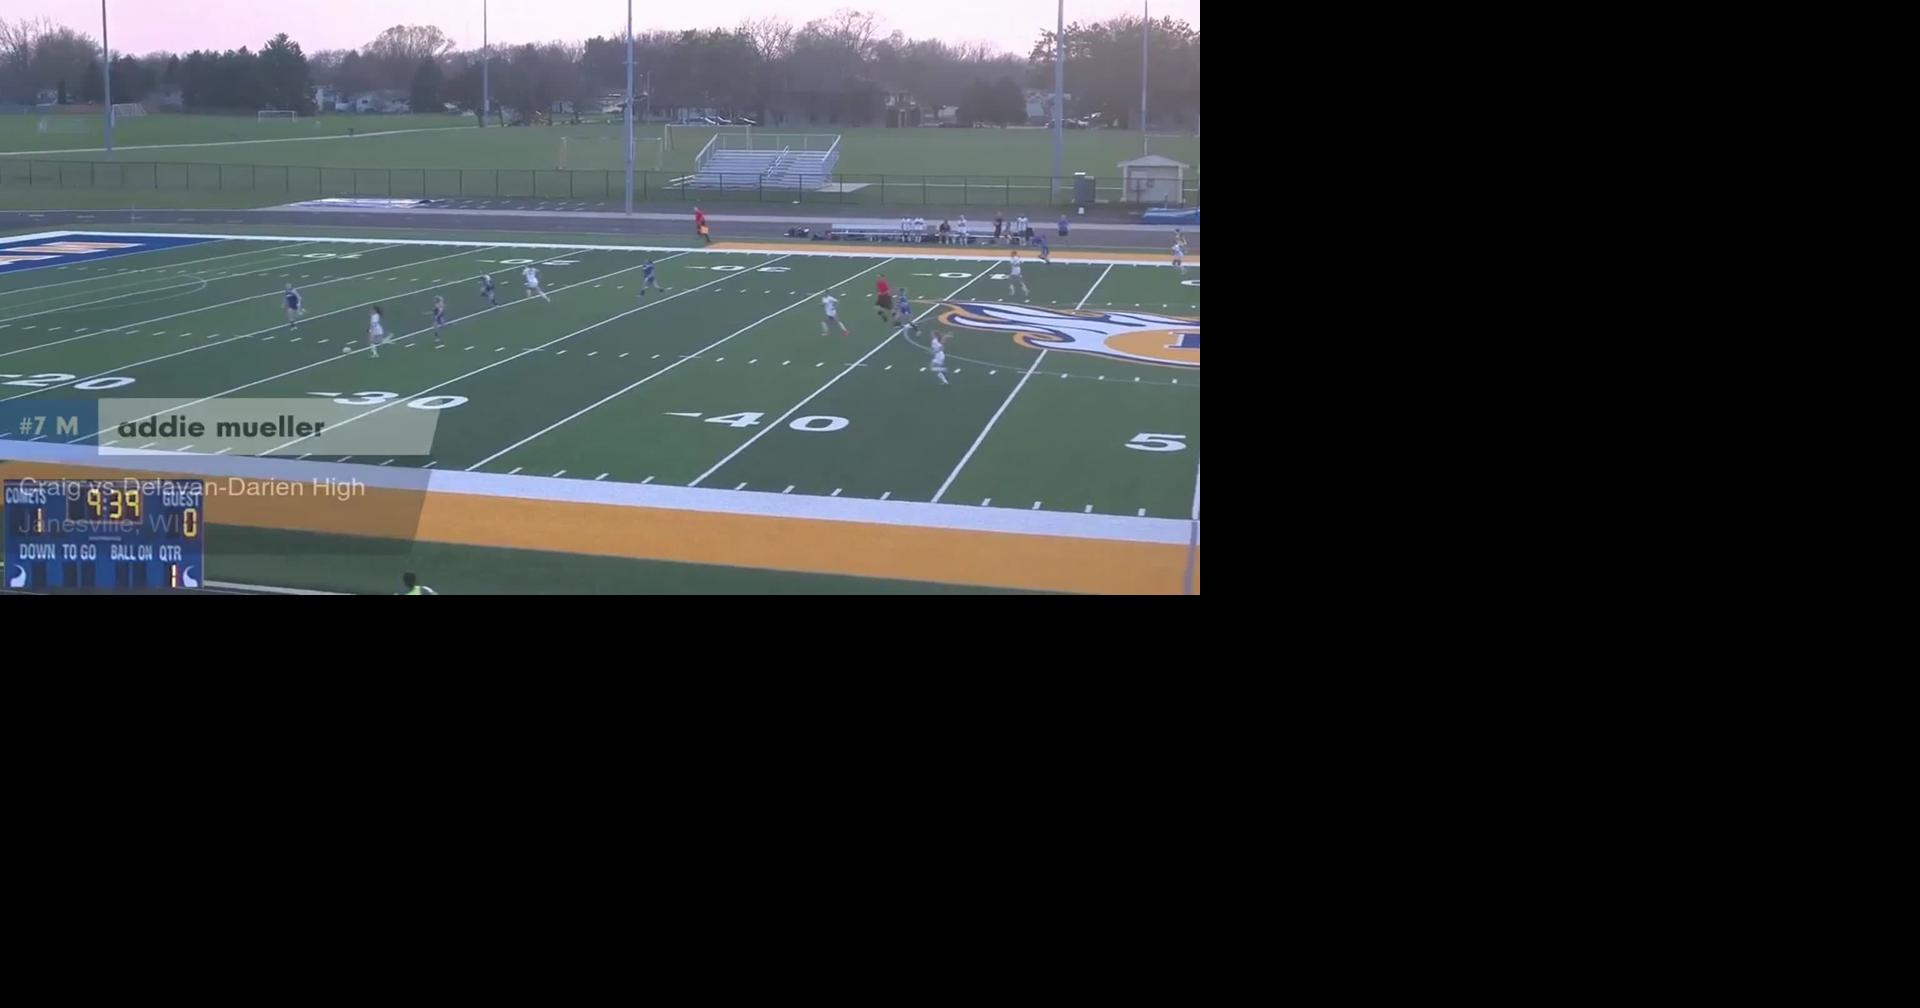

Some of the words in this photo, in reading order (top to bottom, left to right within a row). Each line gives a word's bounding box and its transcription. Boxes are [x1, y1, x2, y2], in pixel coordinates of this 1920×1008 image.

[1, 373, 136, 390] 20
[333, 391, 469, 409] 30
[704, 412, 849, 432] 40
[1124, 433, 1186, 451] 5
[6, 487, 47, 504] COMETS
[87, 488, 140, 519] 9:39
[163, 490, 200, 507] GUEST
[183, 508, 197, 537] 0
[19, 543, 55, 560] DOWN
[63, 544, 77, 560] TO
[80, 544, 96, 560] GO
[110, 544, 137, 561] BALL
[138, 545, 153, 560] ON
[159, 545, 182, 561] QTR
